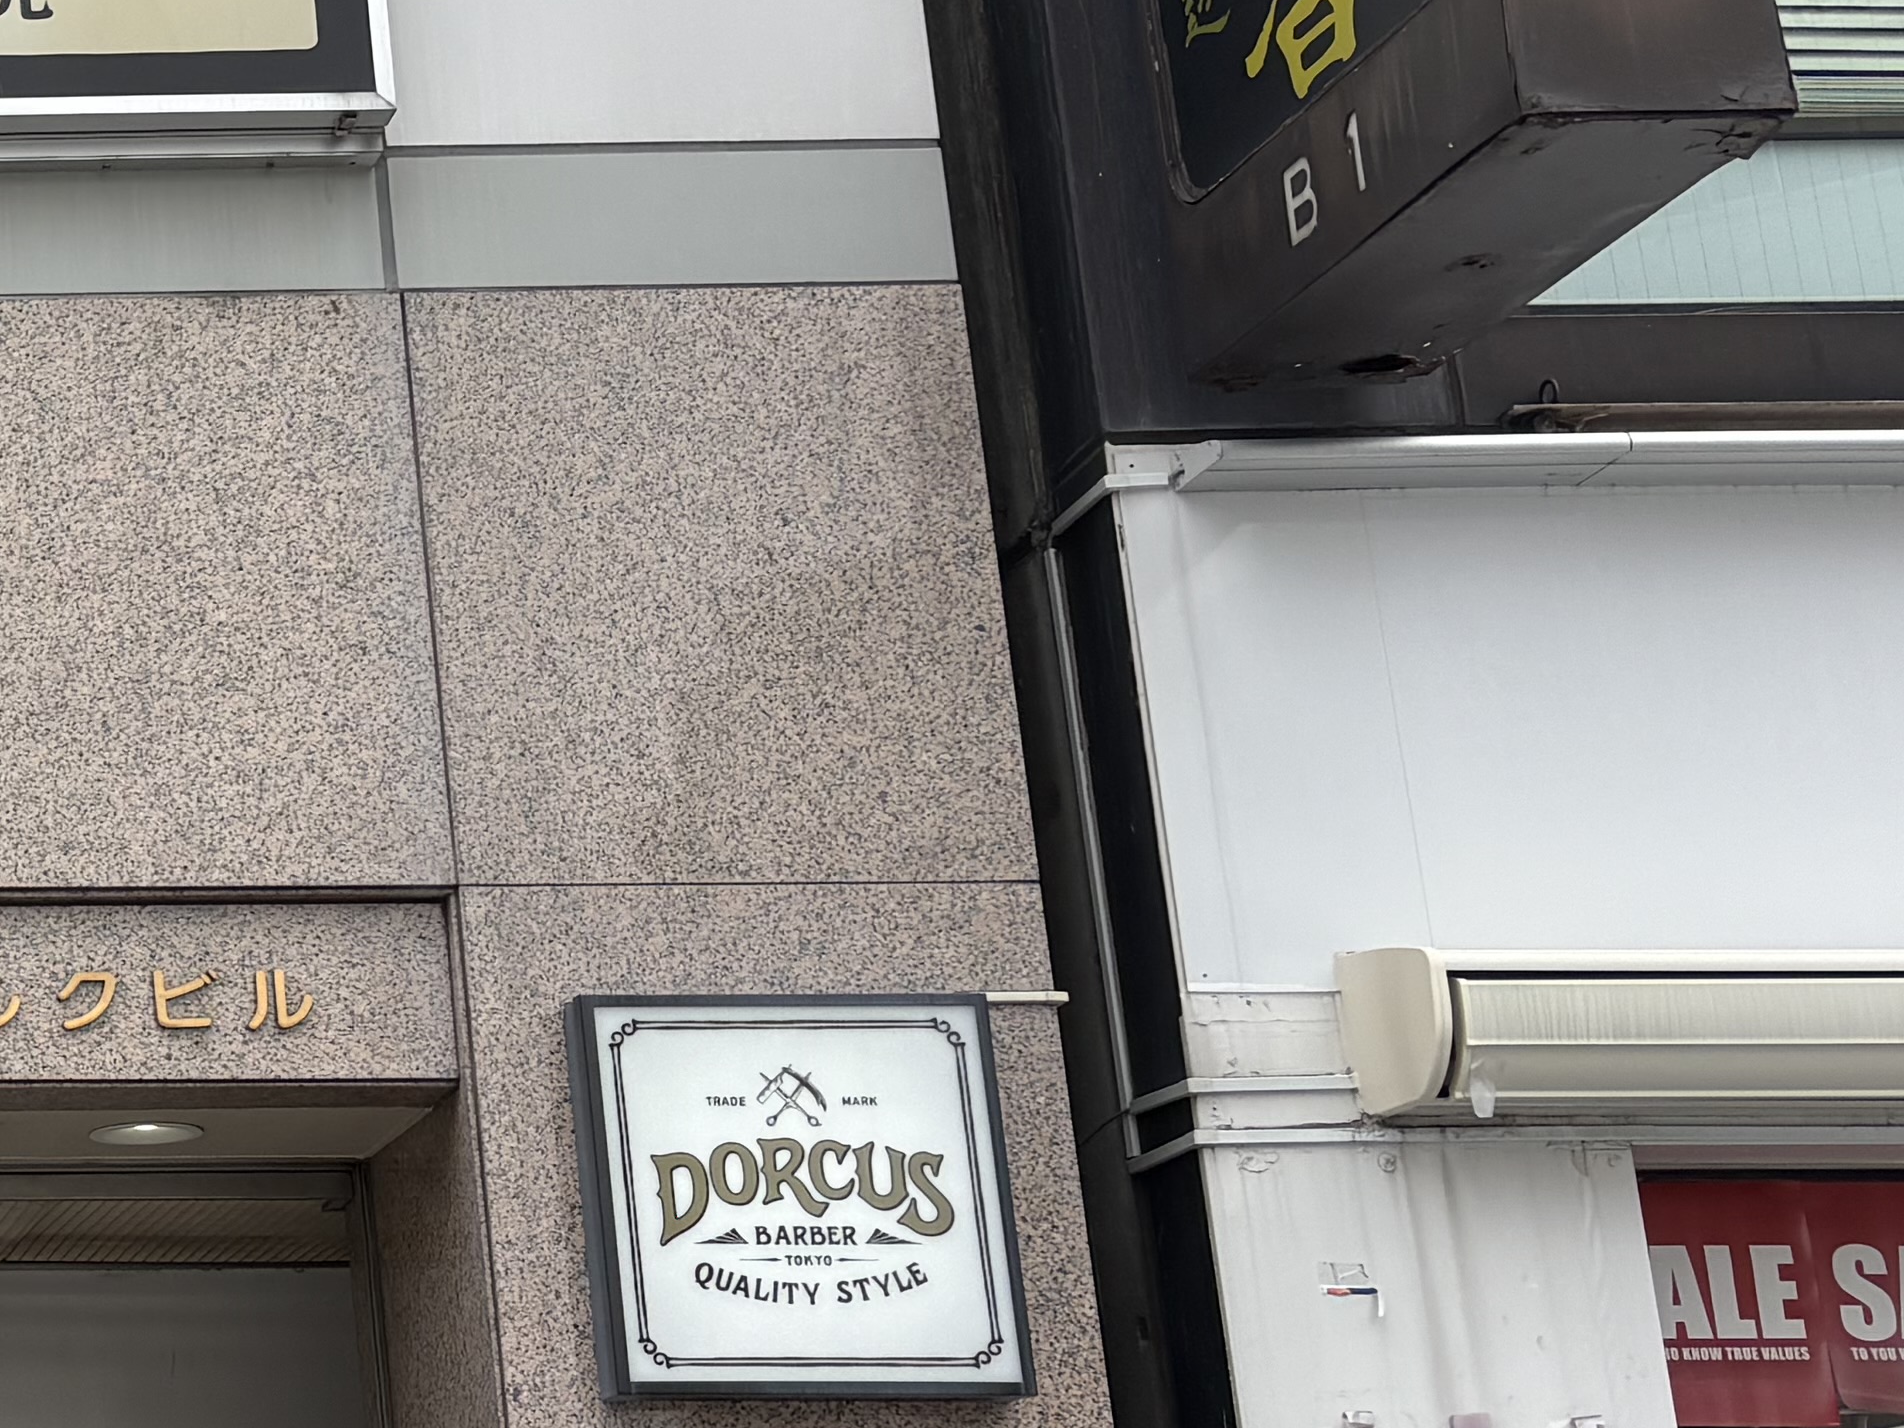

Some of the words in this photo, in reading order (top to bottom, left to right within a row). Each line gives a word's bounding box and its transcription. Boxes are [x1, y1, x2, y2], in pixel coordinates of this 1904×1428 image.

[1285, 113, 1369, 248] B1
[705, 1095, 747, 1108] TRADE
[841, 1095, 879, 1108] MARK
[649, 1136, 956, 1247] DORCUS
[754, 1224, 859, 1247] BARBER
[784, 1254, 834, 1267] TOKYO
[694, 1261, 820, 1306] QUALITY
[837, 1261, 930, 1305] STYLE
[1831, 1242, 1904, 1342] S
[1681, 1346, 1723, 1361] KNOW
[1725, 1346, 1759, 1361] TRUE
[1761, 1346, 1811, 1361] VALUES
[1850, 1346, 1869, 1361] TO
[1871, 1346, 1898, 1361] YOU
